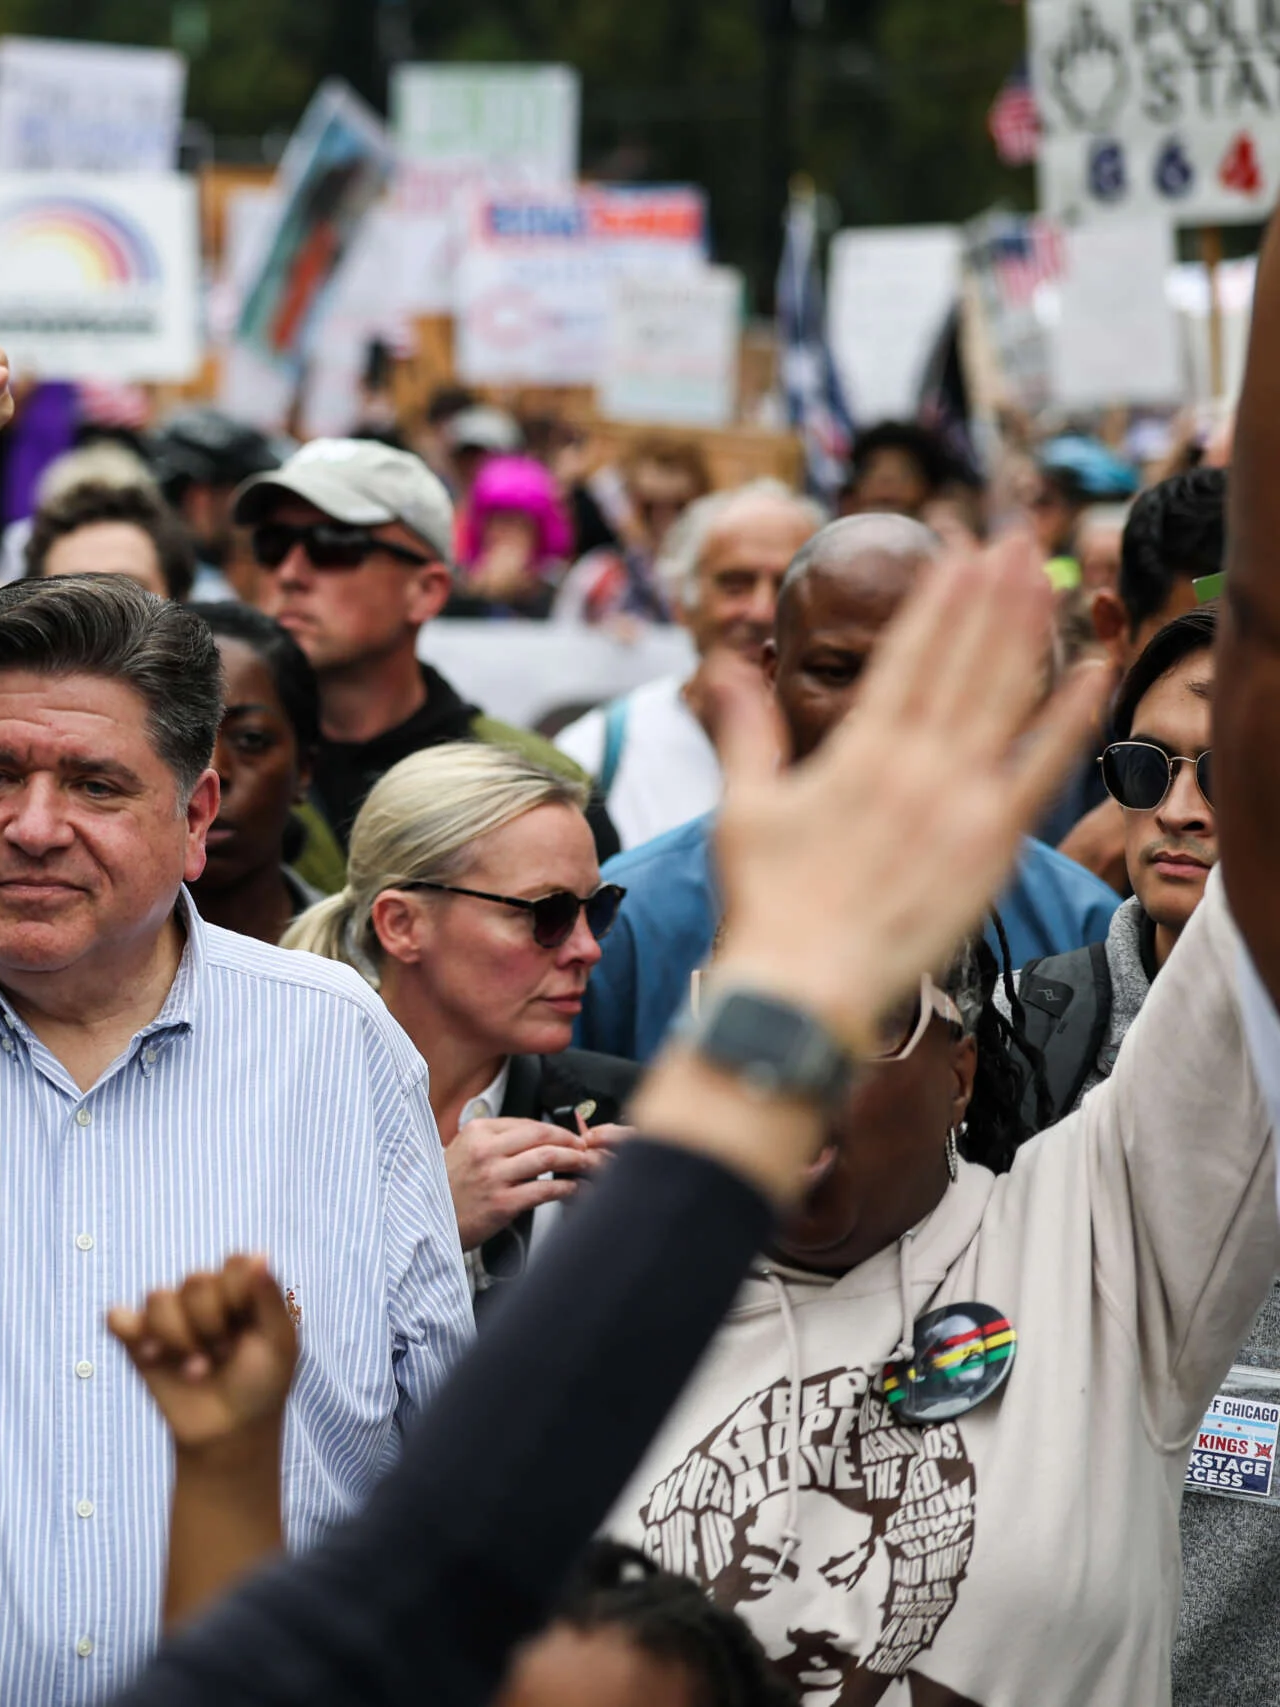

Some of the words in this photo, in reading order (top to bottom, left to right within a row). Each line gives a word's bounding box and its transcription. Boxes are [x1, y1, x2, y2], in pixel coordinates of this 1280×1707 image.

[1141, 57, 1280, 123] STA
[715, 1370, 870, 1446] KEEP
[1223, 1401, 1280, 1423] CHICAGO
[709, 1407, 862, 1477] HOPE
[1198, 1433, 1249, 1455] KINGS
[646, 1451, 733, 1525] NEVER
[862, 1457, 903, 1502] THE
[1184, 1465, 1244, 1488] CESS
[644, 1511, 705, 1588] GIVE
[700, 1509, 737, 1582] UP
[893, 1555, 924, 1586] AND
[925, 1535, 972, 1583] WHITE
[900, 1521, 972, 1558] BLACK
